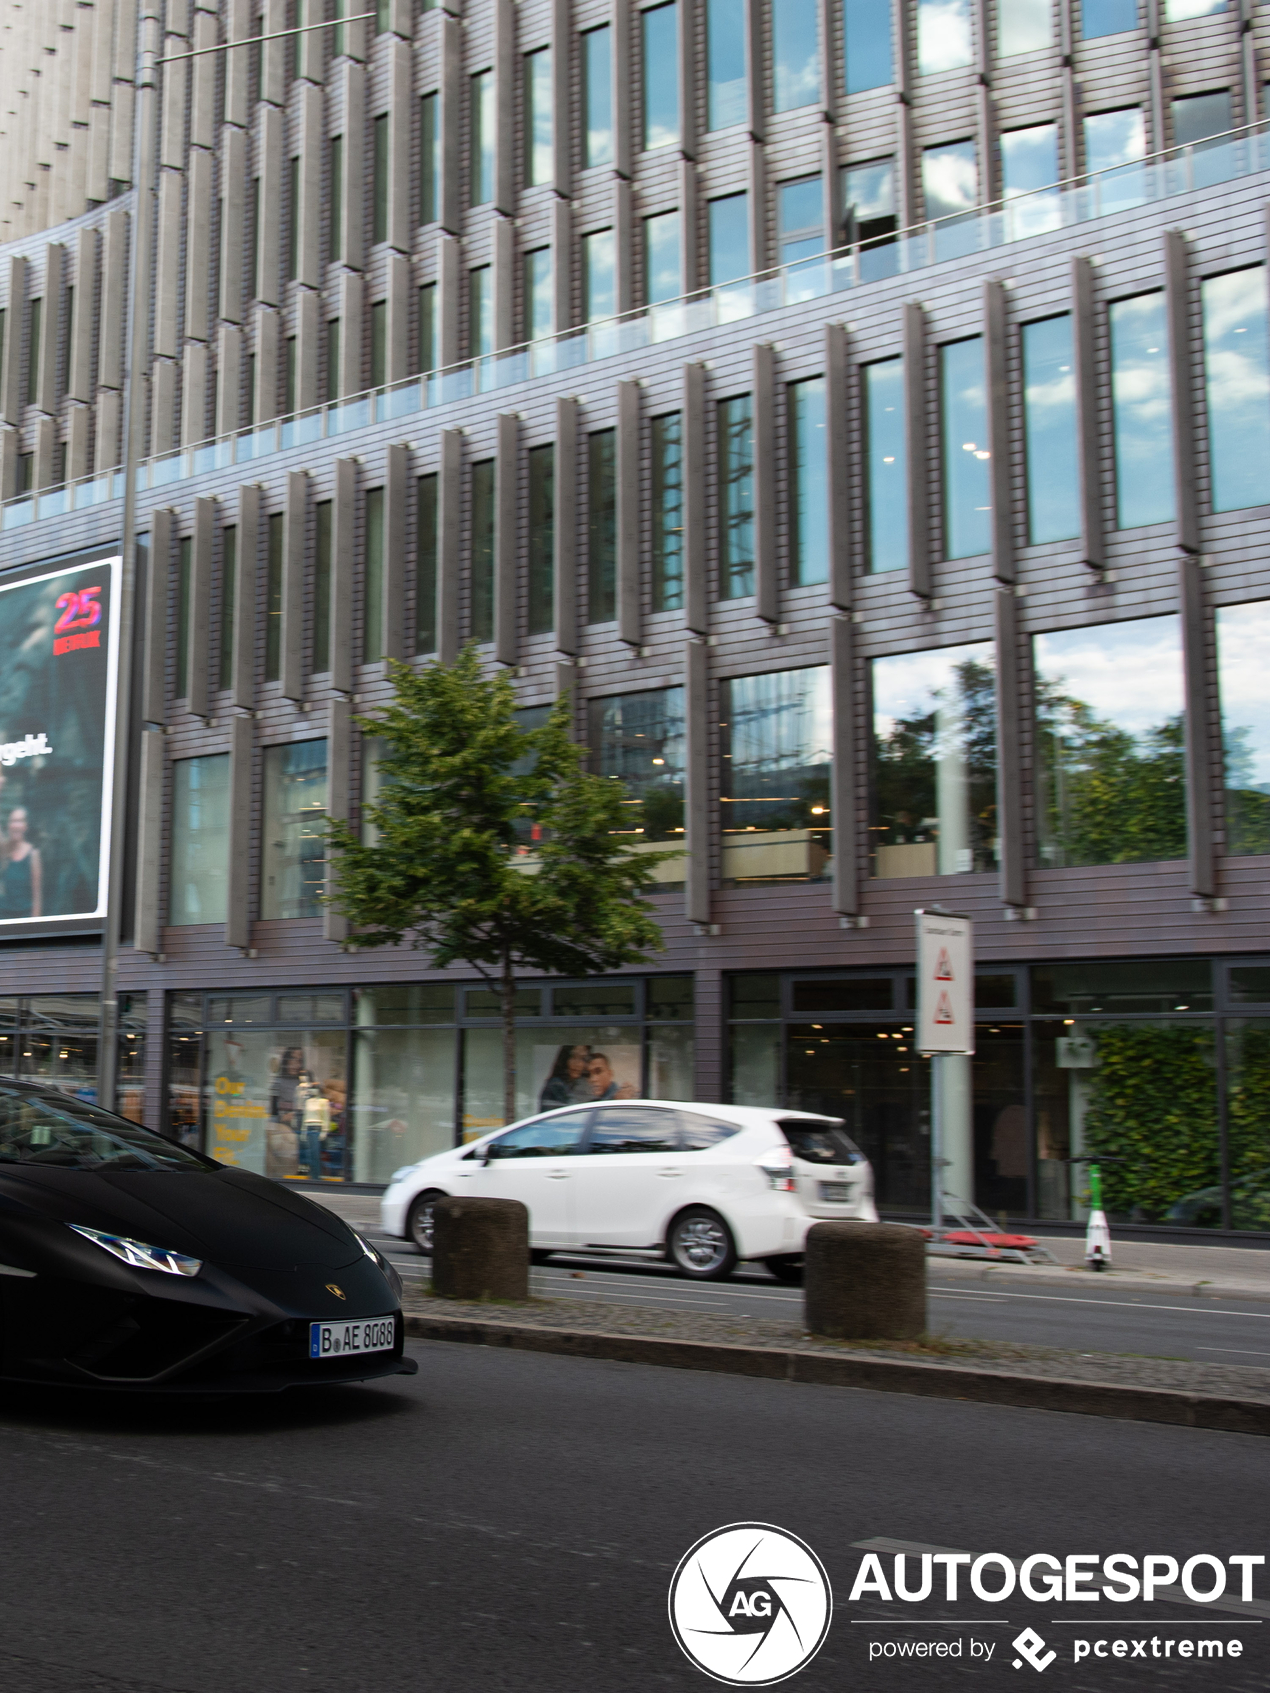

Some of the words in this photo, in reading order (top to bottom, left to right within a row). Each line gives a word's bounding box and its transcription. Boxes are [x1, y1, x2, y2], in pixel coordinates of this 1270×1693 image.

[54, 586, 102, 635] 25
[215, 1077, 246, 1094] Our
[321, 1328, 332, 1353] B
[343, 1324, 360, 1351] AE
[363, 1321, 393, 1348] 8088
